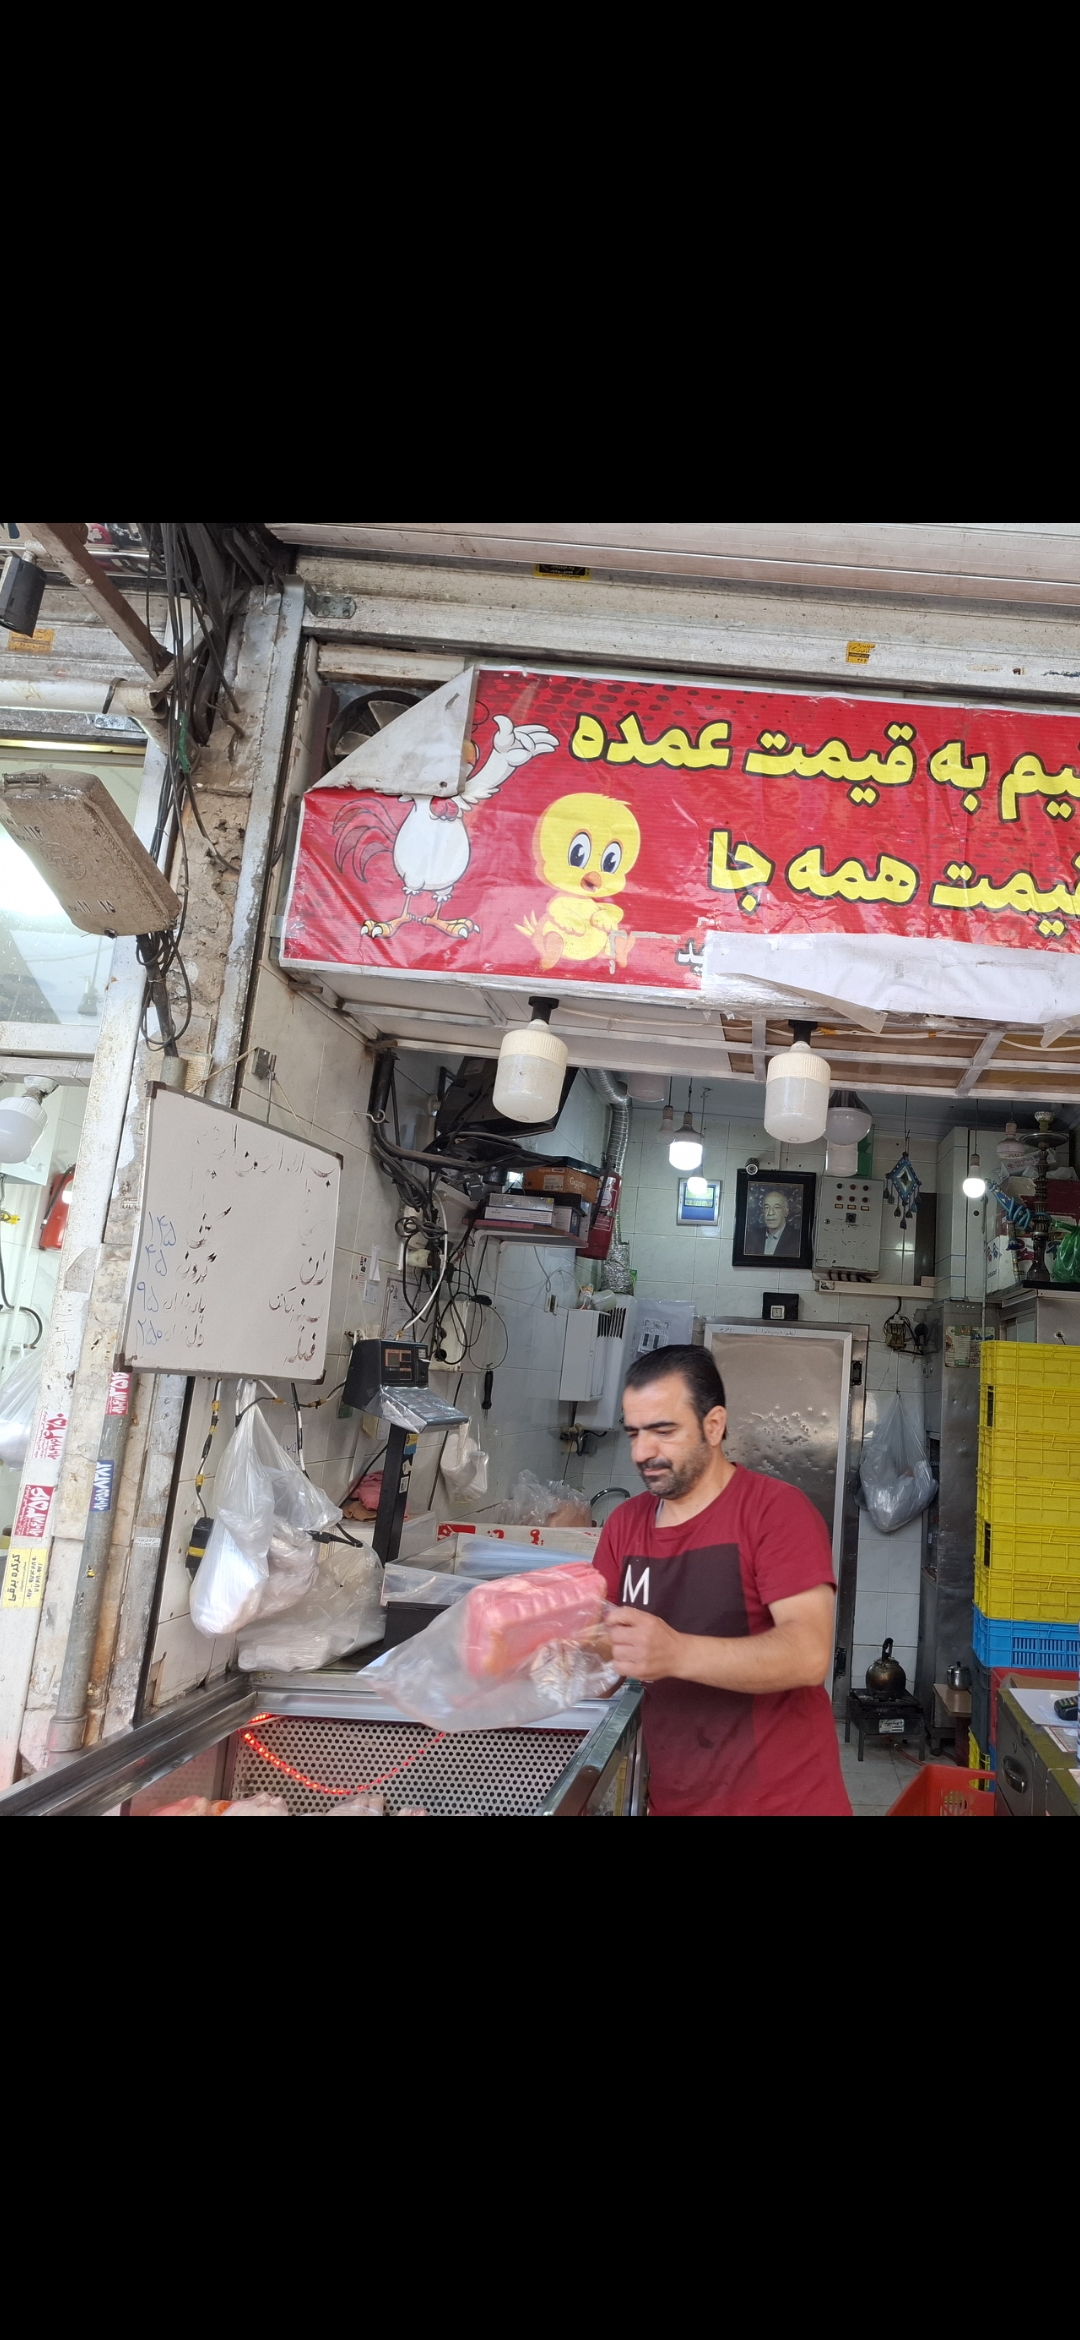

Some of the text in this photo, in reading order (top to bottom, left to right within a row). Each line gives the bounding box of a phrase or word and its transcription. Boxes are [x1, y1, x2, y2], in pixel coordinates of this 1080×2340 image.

[569, 711, 1080, 823] یم به قیمت عمده
[708, 828, 1080, 940] یمت همه جا
[6, 1554, 21, 1602] کرکره برقی
[622, 1564, 649, 1605] M
